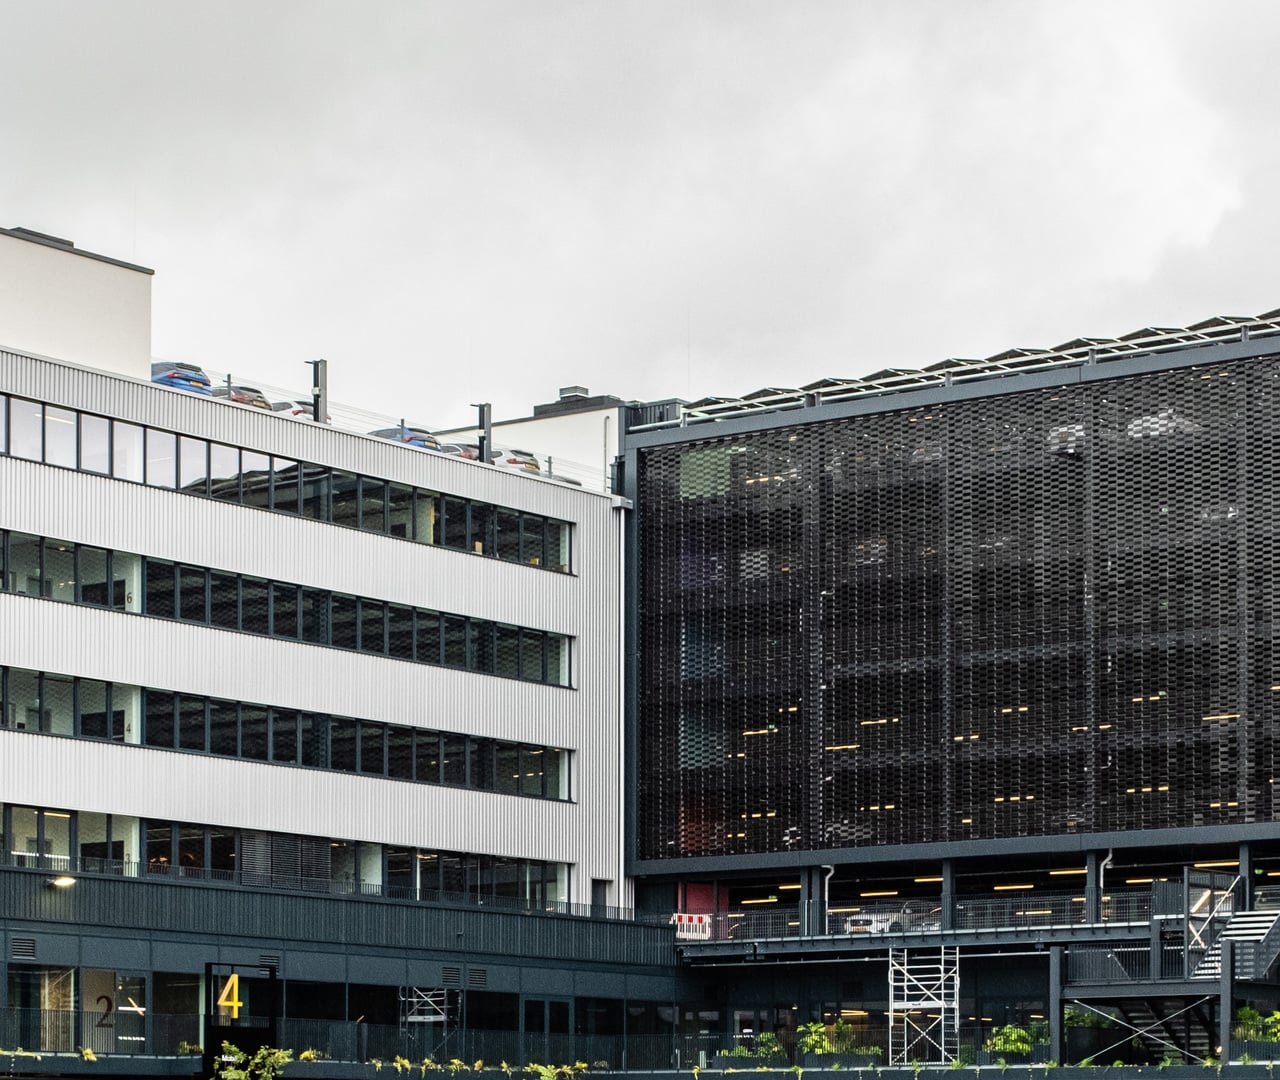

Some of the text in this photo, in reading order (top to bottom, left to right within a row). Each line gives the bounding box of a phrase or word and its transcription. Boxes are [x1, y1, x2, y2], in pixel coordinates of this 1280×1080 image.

[126, 591, 133, 604] 6
[95, 994, 114, 1029] 2
[217, 973, 244, 1019] 4
